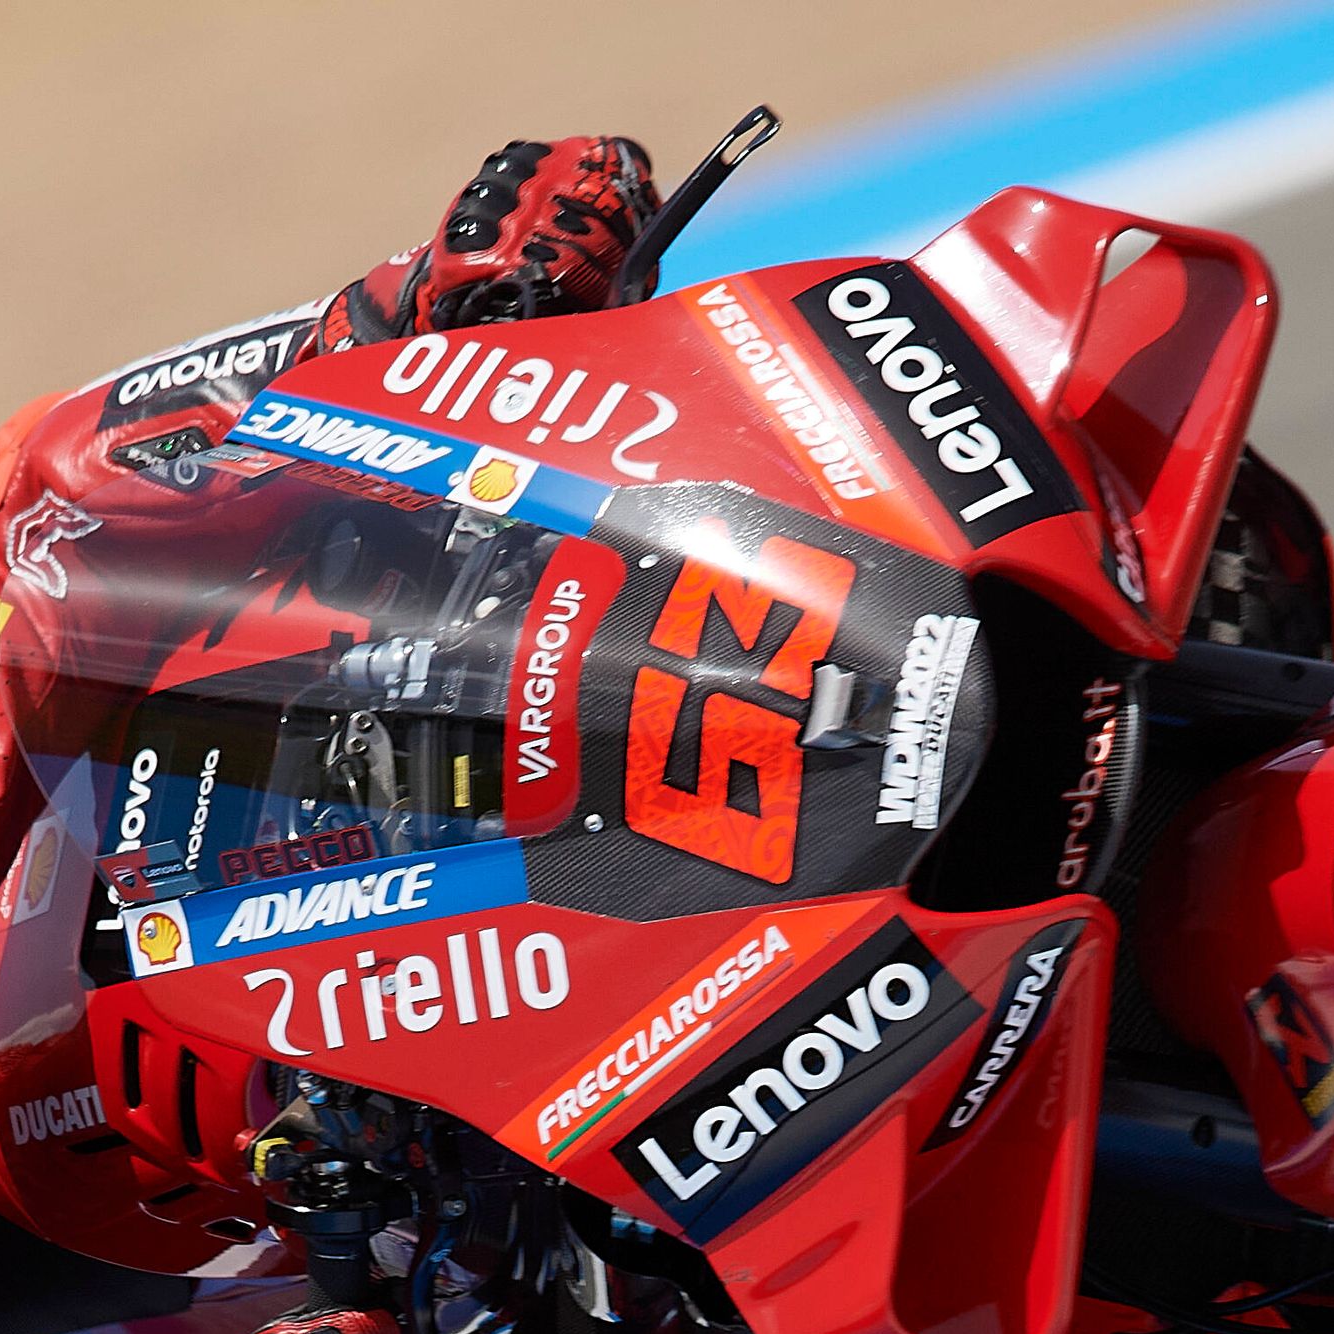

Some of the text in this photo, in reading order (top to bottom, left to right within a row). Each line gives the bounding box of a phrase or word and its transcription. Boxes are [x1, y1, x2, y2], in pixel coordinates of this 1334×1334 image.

[118, 332, 296, 406] Lenovo
[382, 333, 630, 445] riello
[827, 277, 1034, 524] Lenovo
[235, 401, 452, 474] ADVANCE
[624, 516, 857, 885] 63
[1056, 677, 1122, 888] aruba.it
[216, 863, 436, 949] ADVANCE
[219, 823, 376, 887] PECCO
[317, 927, 570, 1049] riello
[535, 926, 791, 1146] FRECCIAROSSA
[948, 945, 1064, 1132] CARRERA
[9, 1085, 108, 1146] DUCATI
[637, 962, 931, 1201] Lenovo
